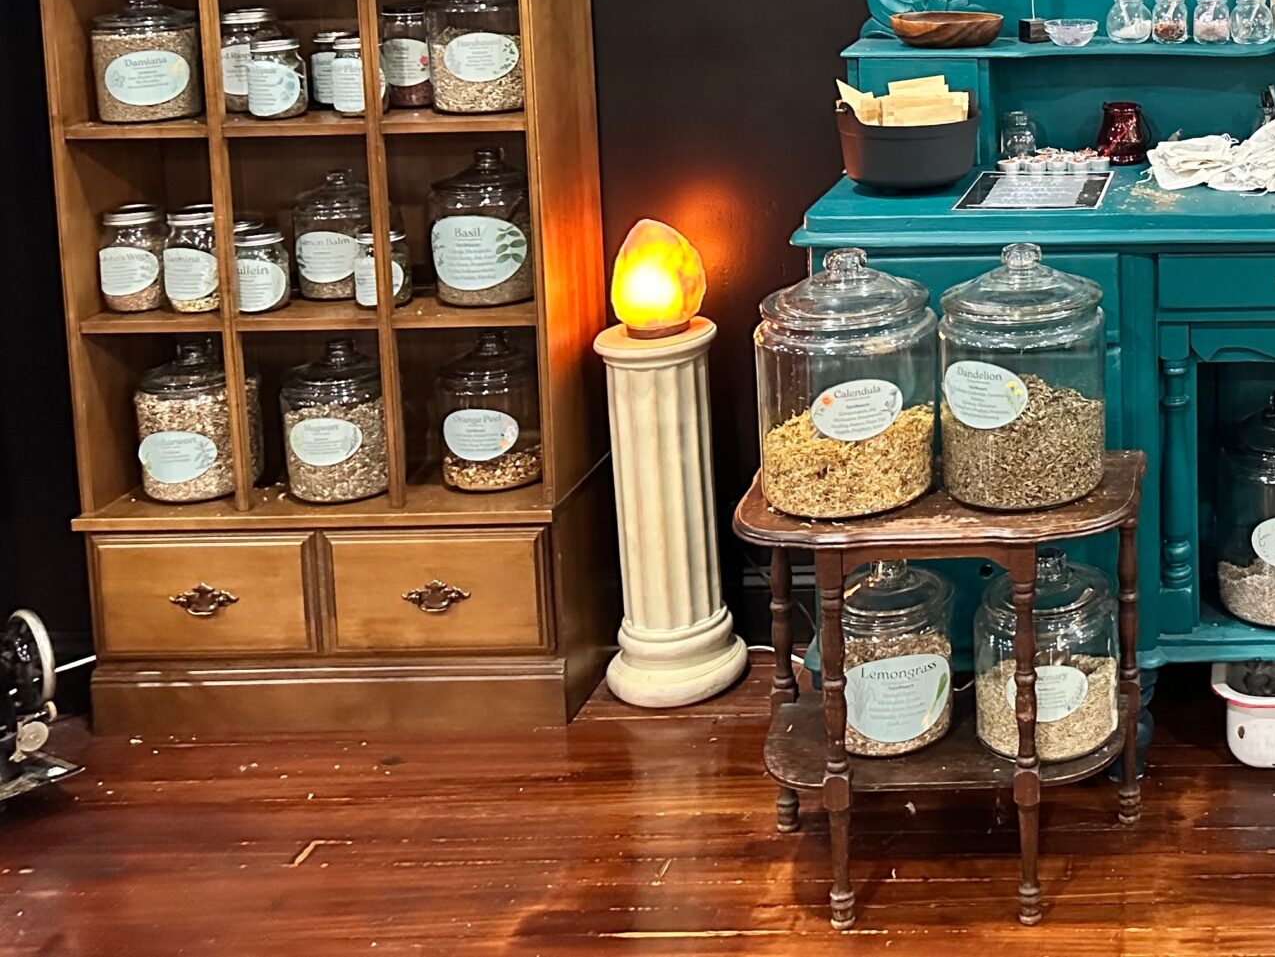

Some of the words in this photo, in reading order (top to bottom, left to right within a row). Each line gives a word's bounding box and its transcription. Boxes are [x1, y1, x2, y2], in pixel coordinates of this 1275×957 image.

[125, 57, 167, 67] Damiana
[454, 227, 481, 238] Basil
[236, 265, 270, 275] ullein
[957, 366, 1002, 381] Dandelion
[833, 385, 881, 399] Calendula
[453, 414, 482, 424] Orange
[483, 414, 502, 423] Peel
[860, 661, 937, 681] Lemongrass
